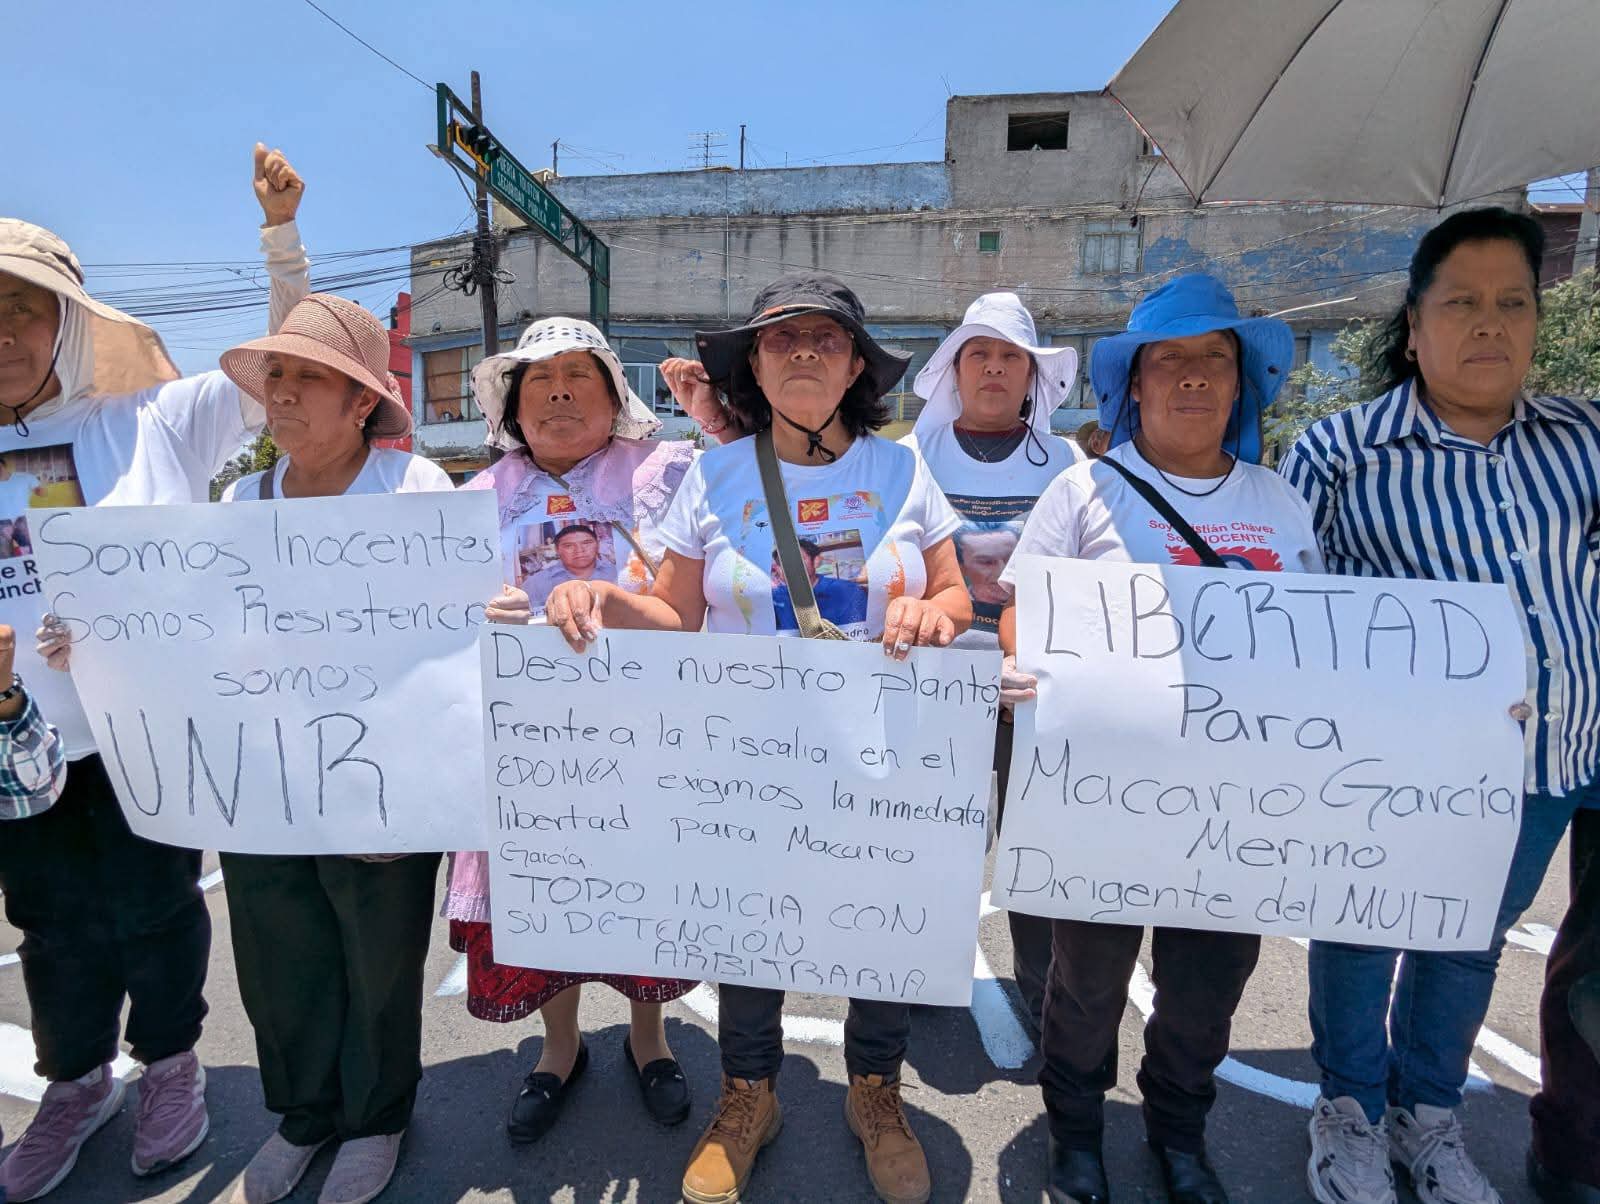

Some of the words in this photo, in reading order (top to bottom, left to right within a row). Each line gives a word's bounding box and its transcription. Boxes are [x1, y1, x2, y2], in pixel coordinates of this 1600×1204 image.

[39, 512, 250, 578] Somos
[274, 509, 494, 567] Inocentes
[53, 591, 215, 644] Somos
[1045, 571, 1491, 680] LIBERTAD
[491, 631, 642, 682] Desde
[678, 645, 845, 692] nuestro
[659, 712, 684, 747] la
[860, 747, 901, 769] en
[920, 738, 956, 777] el
[1168, 684, 1343, 752] Para
[105, 708, 387, 828] UNIR
[496, 755, 624, 787] EDOMEX
[833, 780, 854, 811] la
[869, 794, 985, 828] inmediata
[1021, 739, 1305, 817] Macario
[1320, 758, 1516, 831] García
[498, 796, 631, 831] libertad
[787, 824, 916, 866] Macario
[1185, 818, 1387, 869] Merino
[509, 873, 645, 905] TODO
[675, 883, 803, 924] INICIA
[828, 903, 927, 935] CON
[1006, 846, 1238, 920] Dirigente
[1255, 876, 1317, 927] del
[508, 910, 548, 935] SU
[564, 911, 805, 956] DETENCIÓN
[655, 940, 927, 998] ARBITRARIA
